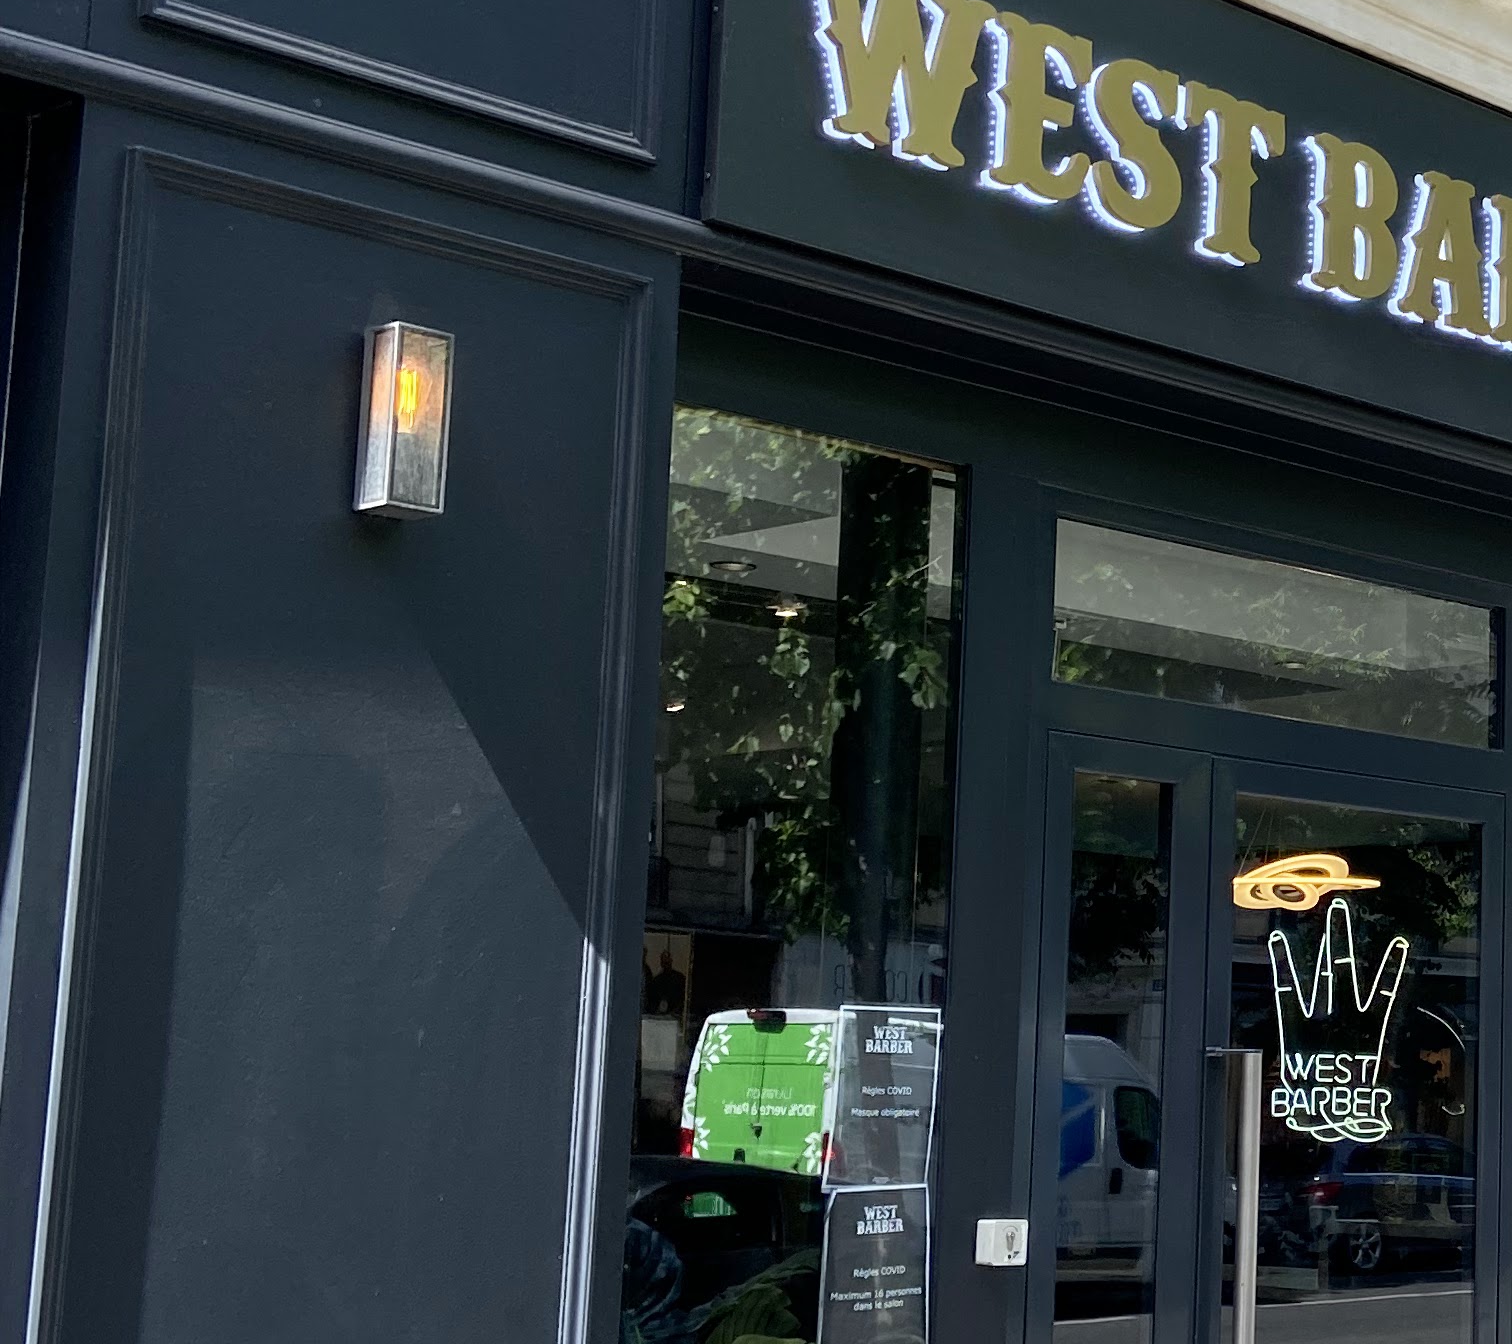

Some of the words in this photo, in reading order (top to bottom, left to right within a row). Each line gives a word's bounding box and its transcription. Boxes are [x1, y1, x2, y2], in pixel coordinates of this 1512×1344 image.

[873, 1025, 908, 1040] WEST
[865, 1039, 914, 1054] BARBER
[1286, 1052, 1379, 1085] WEST
[887, 1086, 912, 1095] COVID
[1271, 1087, 1392, 1128] BARBER
[864, 1204, 898, 1220] WEST
[857, 1218, 904, 1235] BARBER
[881, 1265, 906, 1276] COVID
[830, 1290, 872, 1301] Maximum
[885, 1286, 922, 1299] personnes
[853, 1302, 873, 1312] dans
[874, 1300, 883, 1310] le
[884, 1299, 904, 1309] salon
